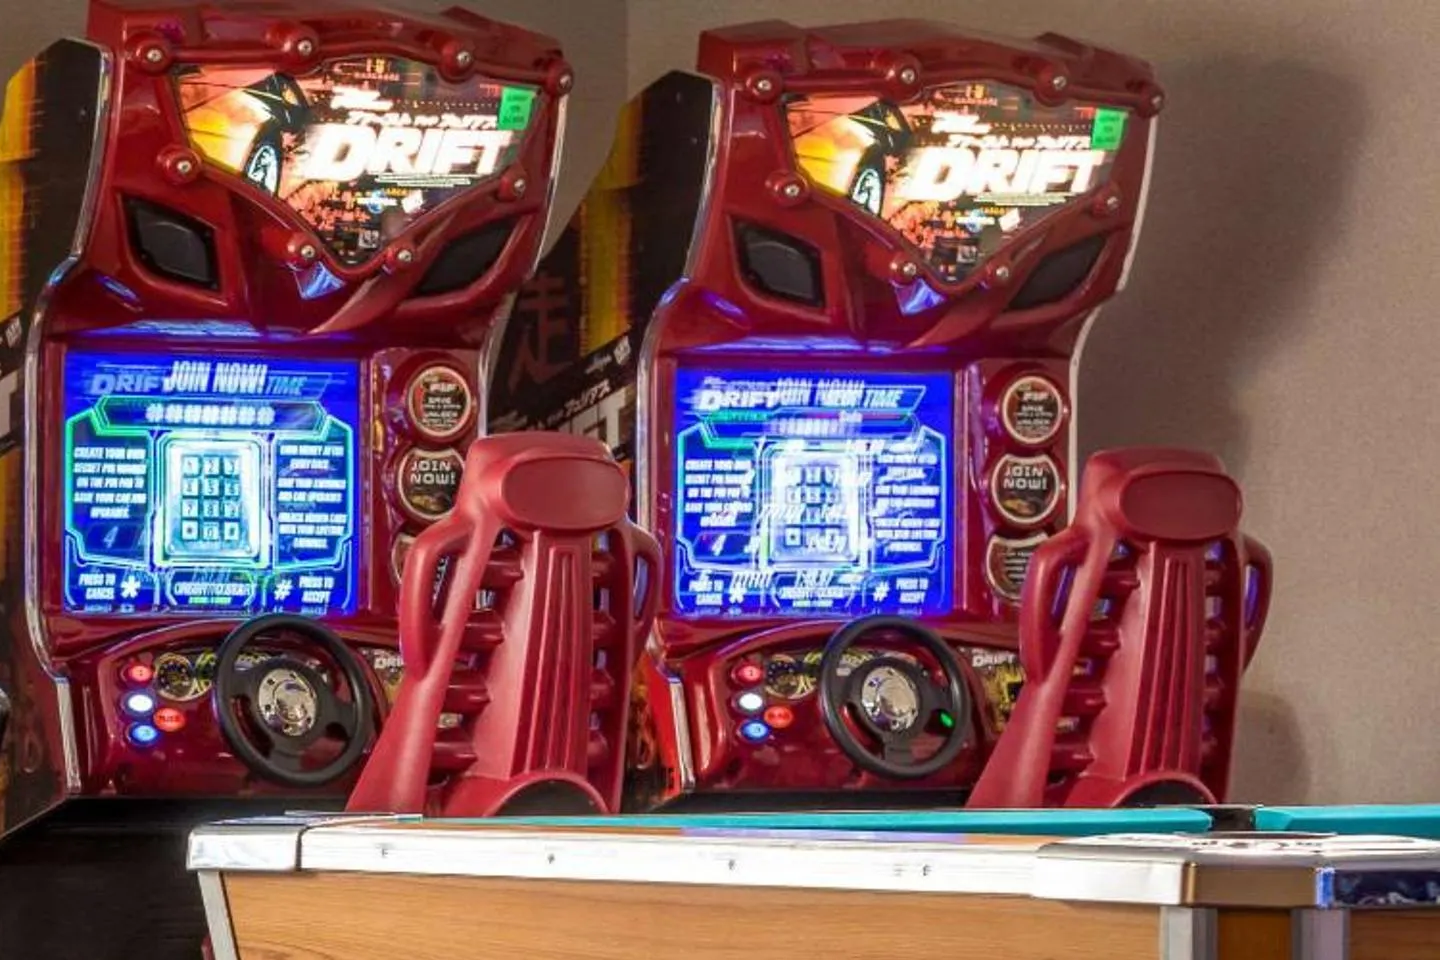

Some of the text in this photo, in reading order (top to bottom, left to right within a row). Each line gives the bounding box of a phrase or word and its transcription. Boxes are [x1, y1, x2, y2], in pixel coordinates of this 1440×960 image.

[302, 123, 513, 181] DRIFT
[900, 146, 1105, 200] DRIFT
[90, 360, 308, 396] DRIF JOIN NOW! TIME
[693, 388, 779, 410] DRIFT
[865, 389, 904, 408] TIME
[410, 460, 452, 472] JOIN
[1004, 465, 1045, 478] JOIN
[410, 472, 457, 485] NOW!
[1002, 478, 1048, 491] NOW!
